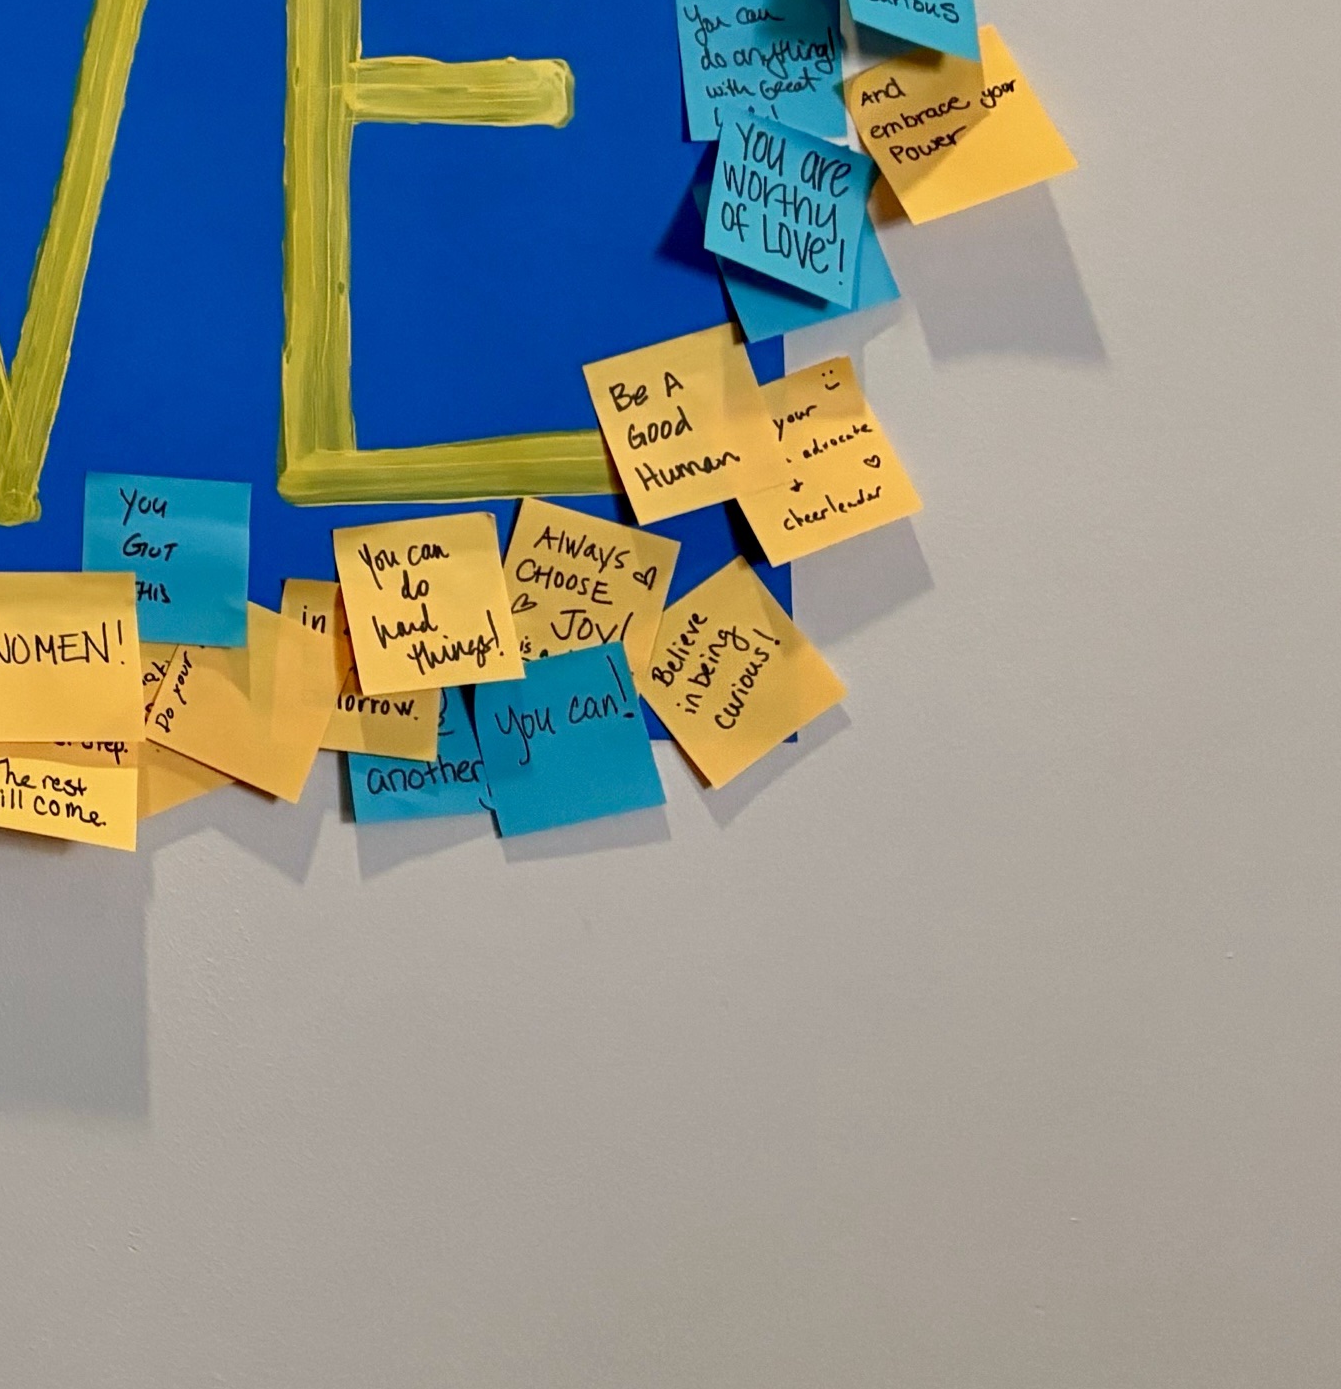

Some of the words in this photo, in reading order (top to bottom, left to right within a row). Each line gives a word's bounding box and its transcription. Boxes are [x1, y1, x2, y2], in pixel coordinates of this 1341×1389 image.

[684, 5, 728, 43] You
[869, 93, 971, 140] embrace
[801, 151, 851, 197] are
[610, 383, 649, 411] Be
[627, 406, 693, 450] Good
[802, 424, 873, 460] advocate
[784, 484, 882, 532] cheerleader
[401, 571, 429, 601] do
[516, 559, 613, 605] CHOOSE
[651, 612, 708, 689] Believe
[696, 623, 750, 689] being
[714, 627, 781, 731] curious!
[494, 706, 556, 766] you
[569, 656, 634, 724] can!
[41, 773, 87, 796] rest
[367, 759, 484, 795] another
